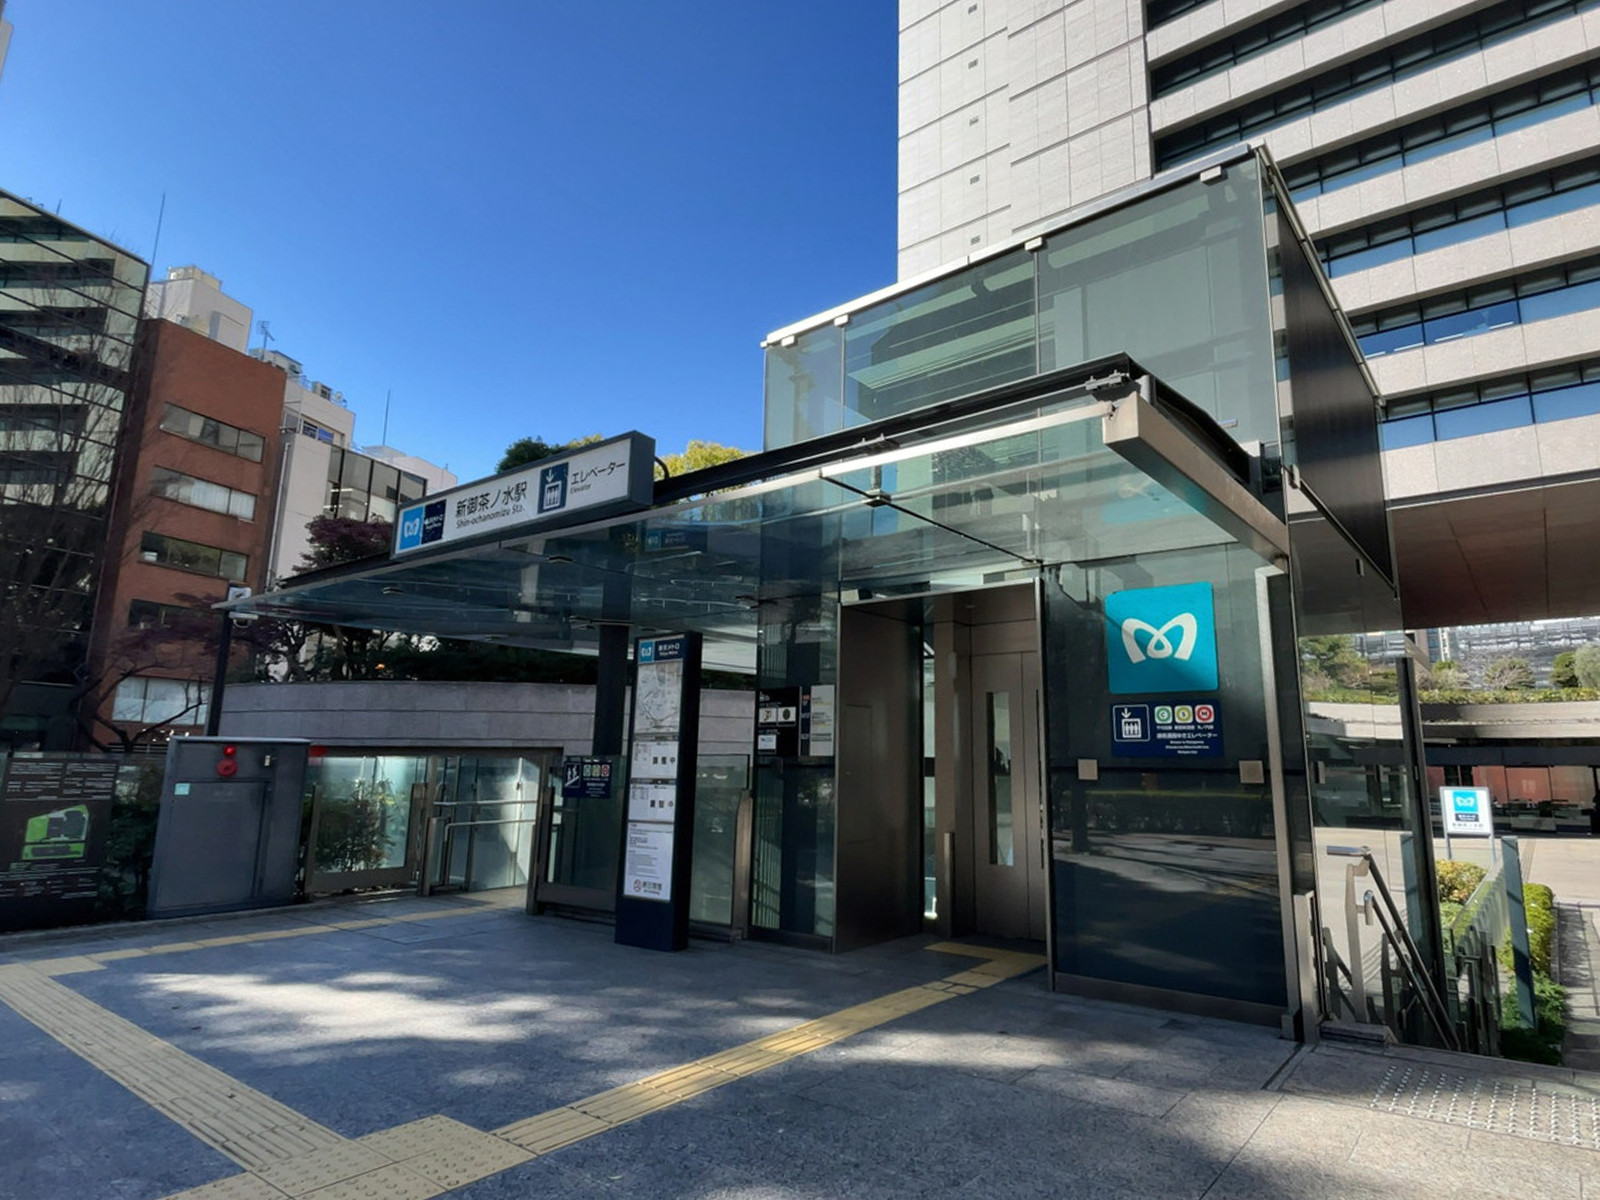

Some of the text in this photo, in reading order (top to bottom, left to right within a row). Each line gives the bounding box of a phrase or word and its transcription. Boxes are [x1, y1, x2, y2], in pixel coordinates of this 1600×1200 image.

[571, 462, 626, 485] エレベーター
[455, 480, 528, 518] 新御茶ノ水駅
[455, 508, 511, 529] Shin-ochanomizu
